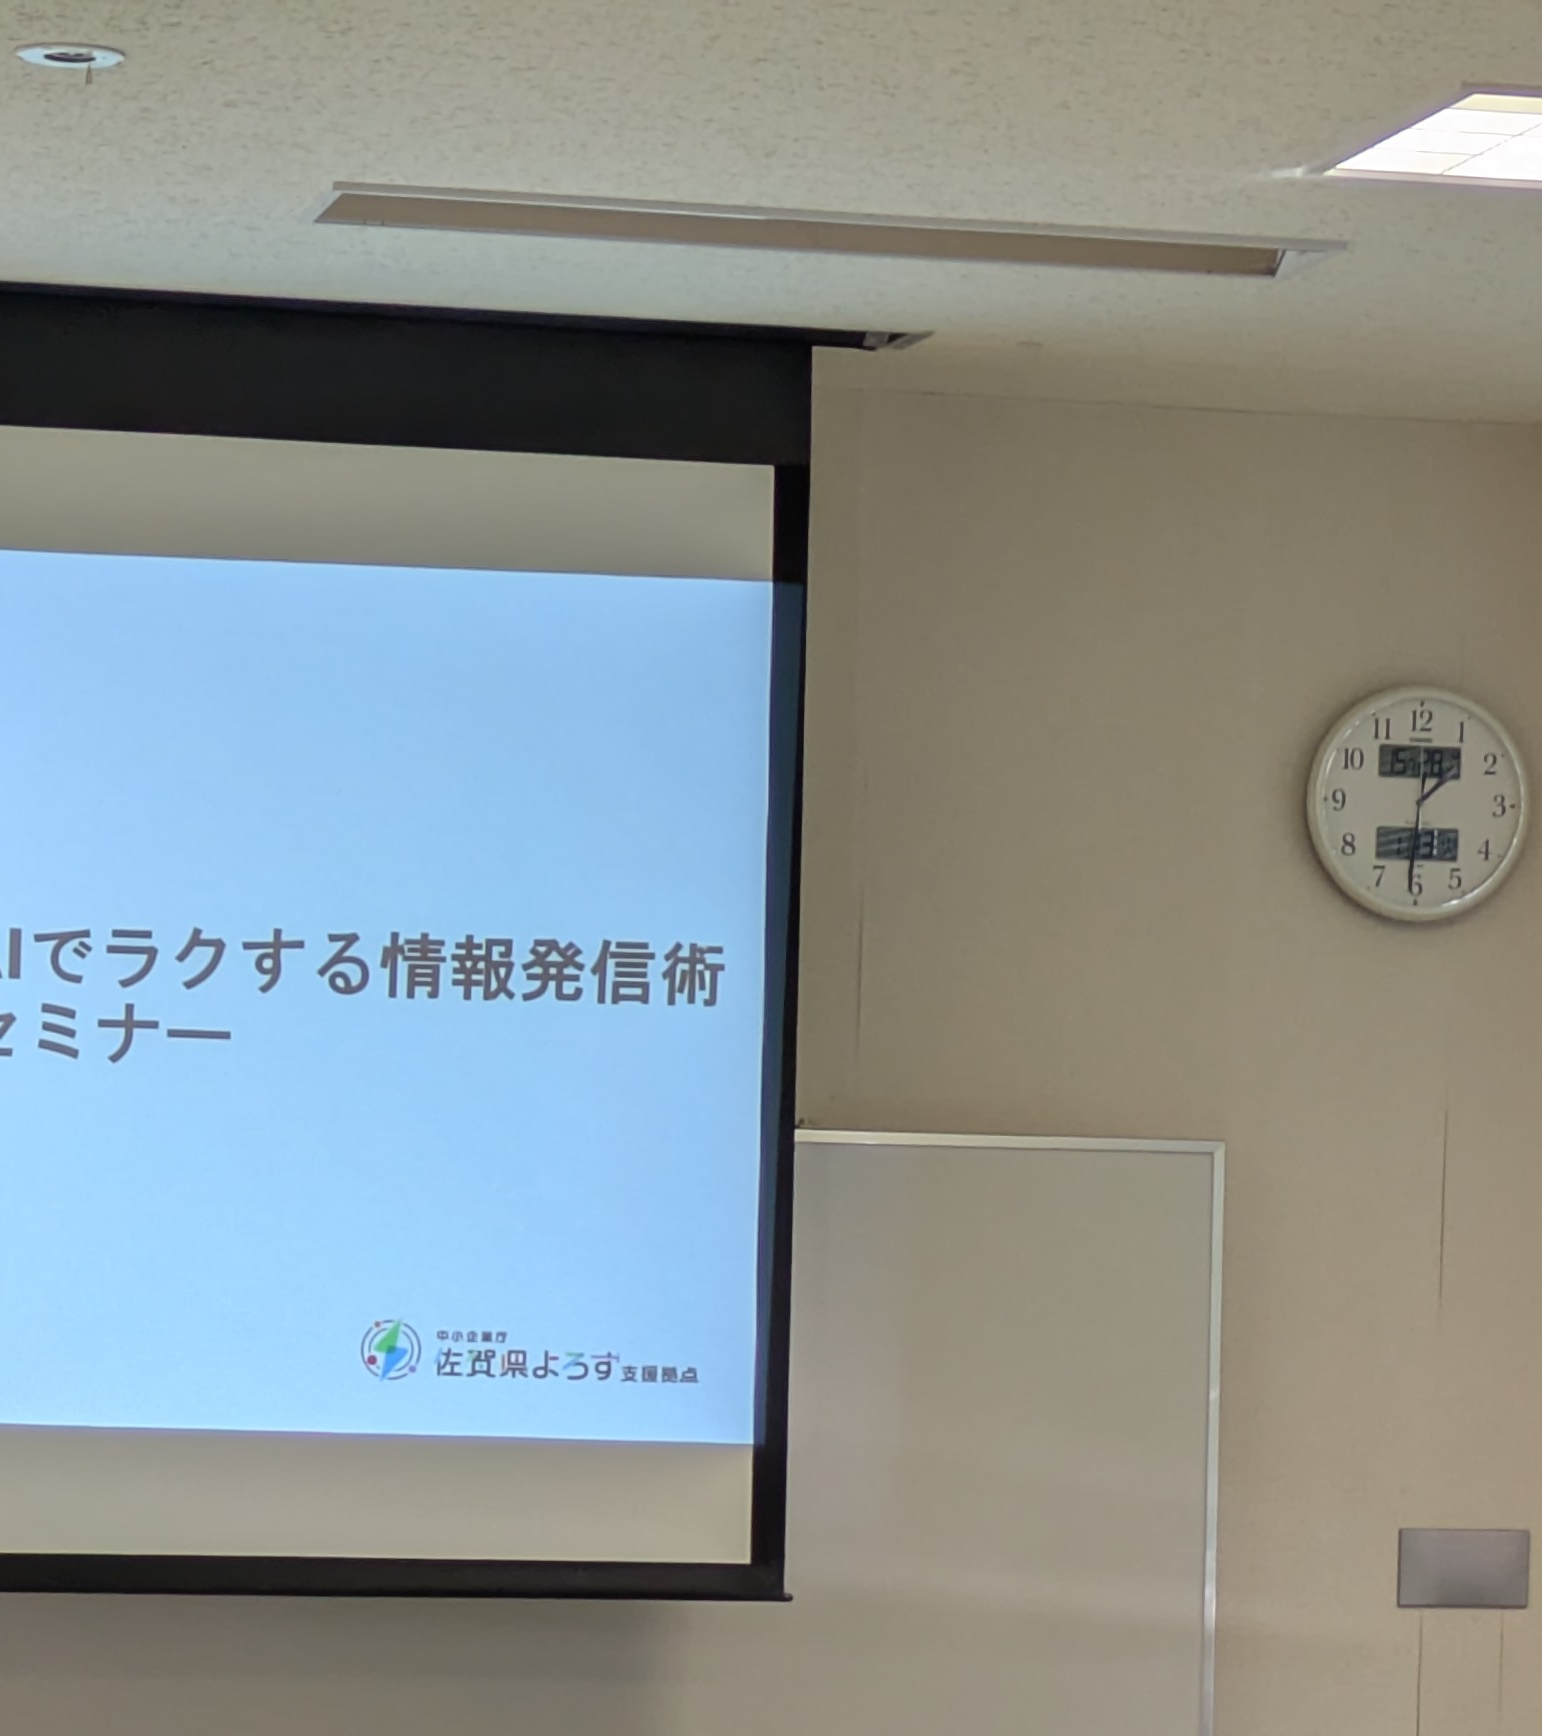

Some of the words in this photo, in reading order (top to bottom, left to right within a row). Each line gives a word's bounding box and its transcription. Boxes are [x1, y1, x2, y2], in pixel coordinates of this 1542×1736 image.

[1373, 717, 1391, 740] 11
[1410, 709, 1433, 732] 12
[1458, 721, 1465, 743] 1
[1341, 748, 1364, 770] 10
[1483, 753, 1497, 775] 2
[1332, 788, 1346, 811] 9
[1492, 794, 1506, 818] 3
[1341, 833, 1356, 856] 8
[1477, 839, 1491, 861] 4
[1372, 865, 1386, 887] 7
[1409, 873, 1423, 896] 6
[1448, 868, 1462, 890] 5
